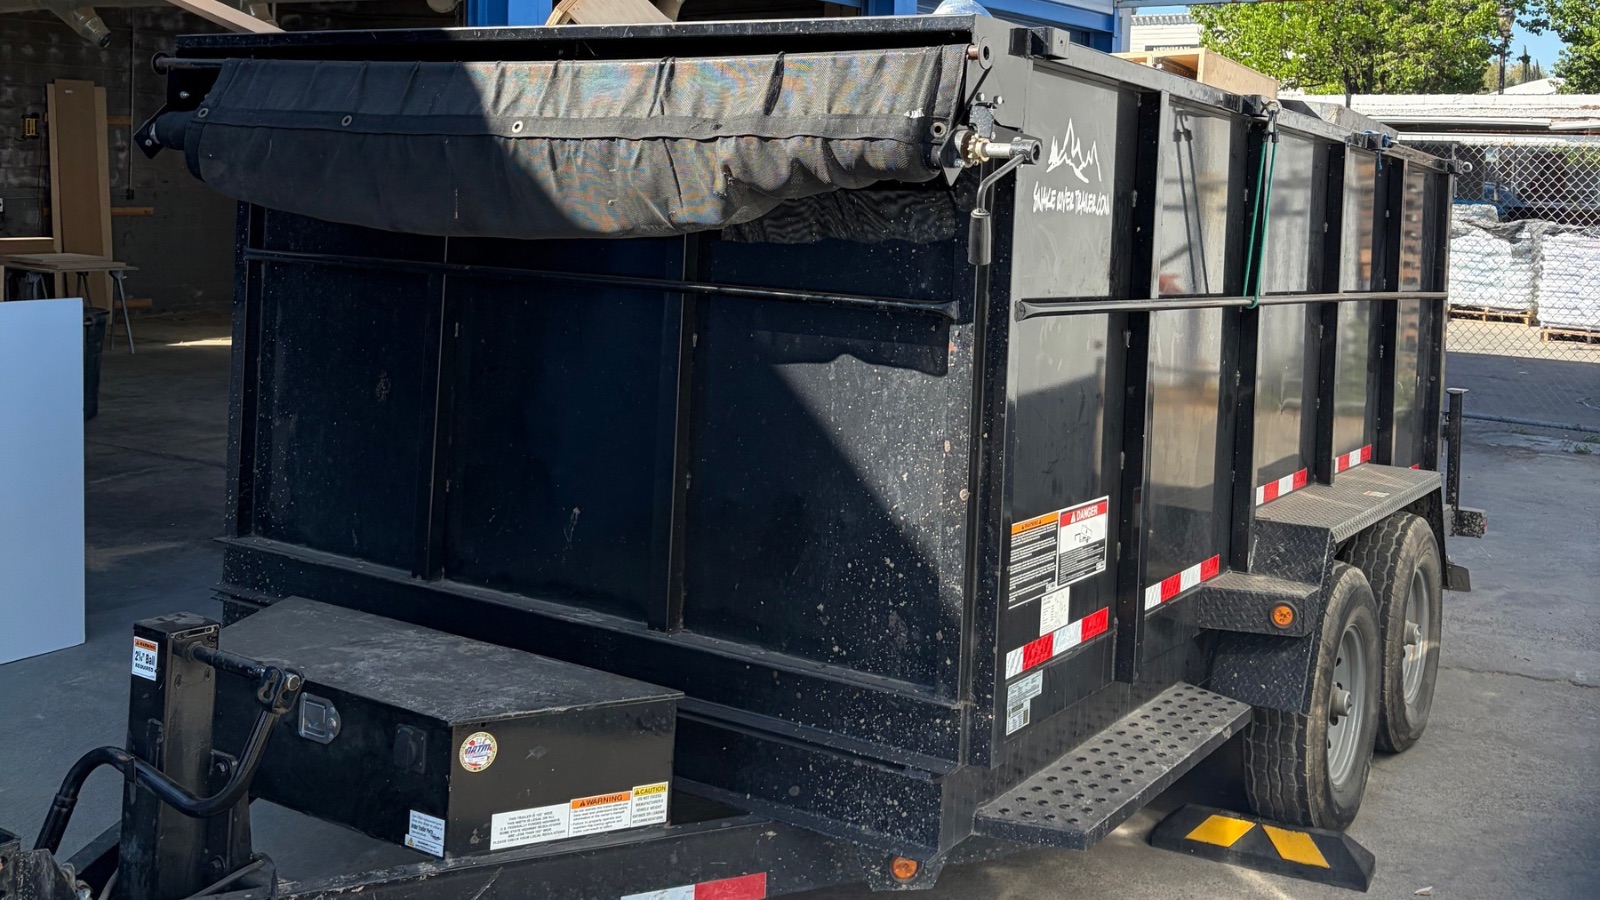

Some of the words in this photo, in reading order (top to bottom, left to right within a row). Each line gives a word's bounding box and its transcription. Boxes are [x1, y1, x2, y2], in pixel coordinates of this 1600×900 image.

[1033, 181, 1056, 213] SNAKE
[1057, 186, 1075, 213] RIVER
[1076, 505, 1098, 520] DANGER
[146, 654, 155, 666] Ball
[135, 662, 154, 672] REQUIRED
[640, 785, 666, 795] CAUTION
[586, 794, 622, 806] WARNING
